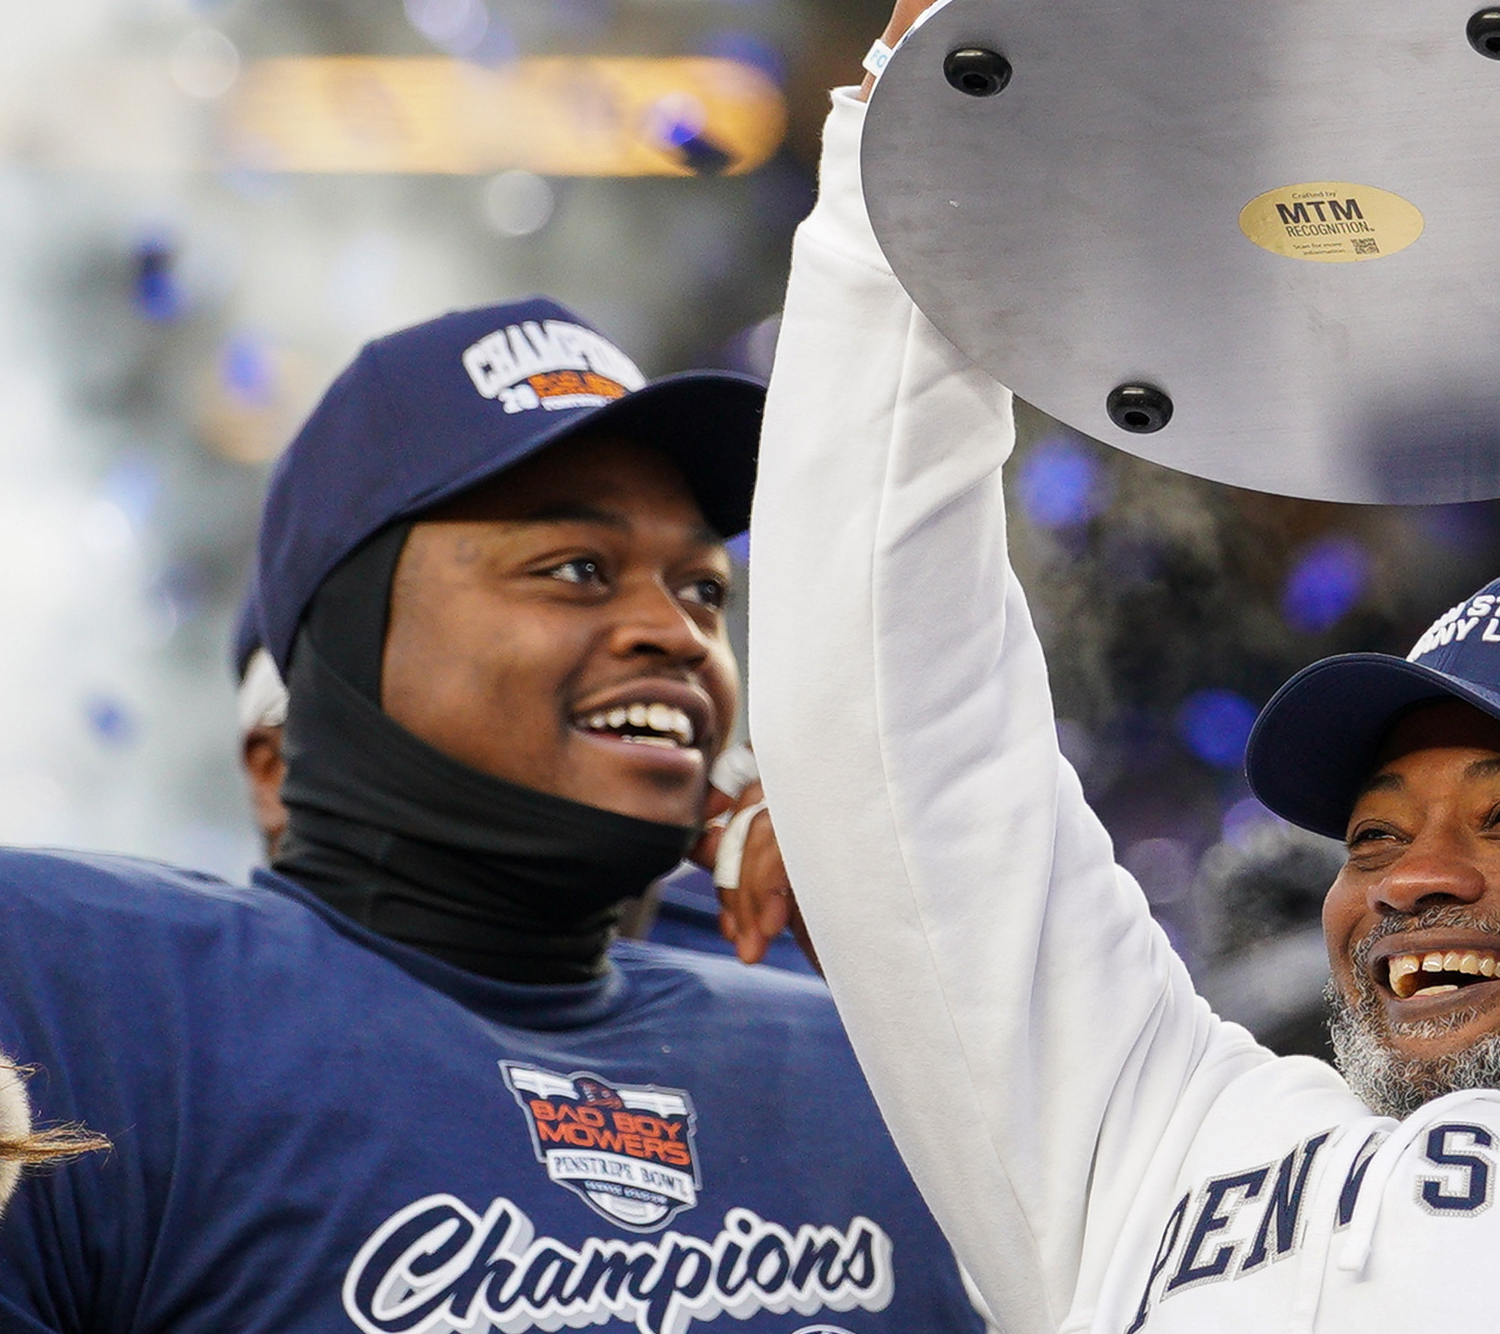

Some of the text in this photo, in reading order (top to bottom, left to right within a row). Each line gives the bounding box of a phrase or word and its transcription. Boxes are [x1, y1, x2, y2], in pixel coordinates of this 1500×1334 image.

[1275, 198, 1364, 224] MTM
[1285, 221, 1370, 238] RECOGNITION
[529, 1099, 682, 1141] BAD BOY
[536, 1120, 691, 1166] MOWERS
